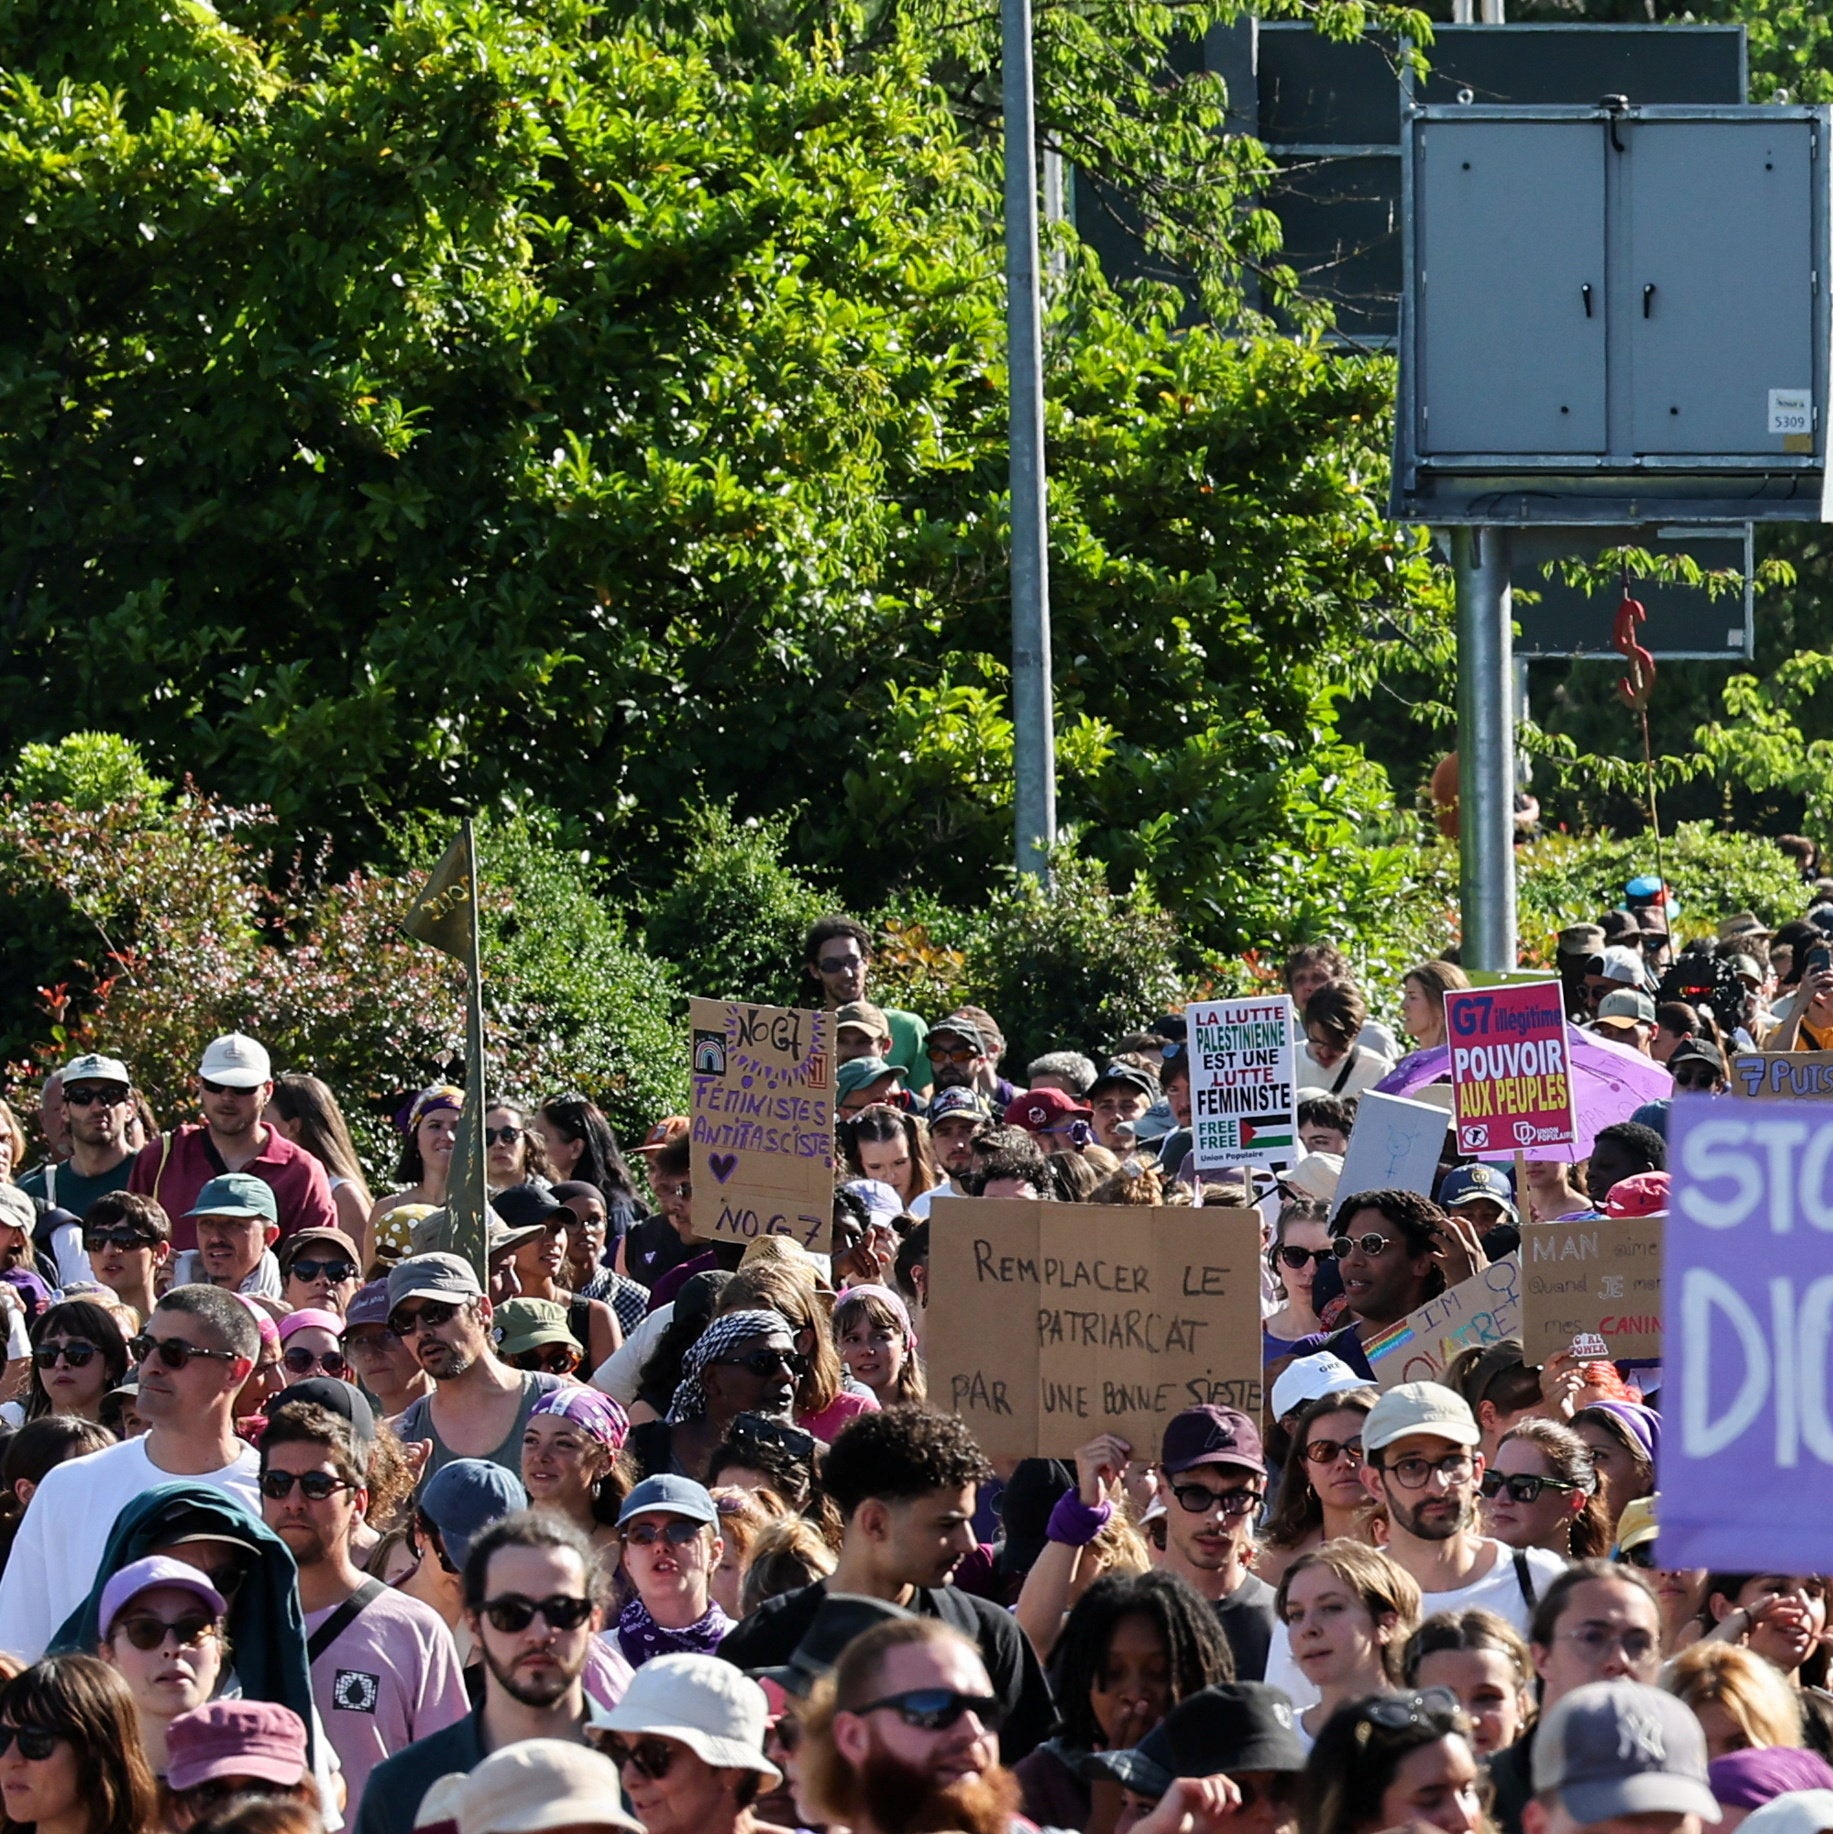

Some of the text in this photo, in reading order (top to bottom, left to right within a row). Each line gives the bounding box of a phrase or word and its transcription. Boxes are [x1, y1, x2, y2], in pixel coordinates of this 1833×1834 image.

[1775, 416, 1805, 428] 5309
[1196, 1007, 1285, 1026] LA LUTTE
[1452, 996, 1494, 1037] G7
[1196, 1022, 1286, 1053] PALESTINIENNE
[1204, 1049, 1279, 1070] EST UNE
[1454, 1039, 1565, 1084] POUVOIR
[1213, 1067, 1275, 1086] LUTTE
[1735, 1057, 1766, 1097] 7
[1197, 1083, 1291, 1116] FÉMINISTE
[1460, 1073, 1568, 1119] AUX PEUPLES
[1199, 1120, 1237, 1135] FREE
[1200, 1135, 1237, 1150] FREE
[1537, 1126, 1560, 1136] UNION
[1201, 1151, 1264, 1162] Union Populaire
[714, 1205, 759, 1238] NO
[974, 1239, 1231, 1297] REMPLACER LE
[1528, 1273, 1625, 1300] Quand JE
[1416, 1291, 1462, 1334] I'M
[1545, 1318, 1585, 1335] mes
[1039, 1309, 1208, 1356] PATRIARCAT
[953, 1375, 1011, 1416] PAR
[1043, 1379, 1088, 1418] UNE
[1104, 1380, 1168, 1417] BONNE
